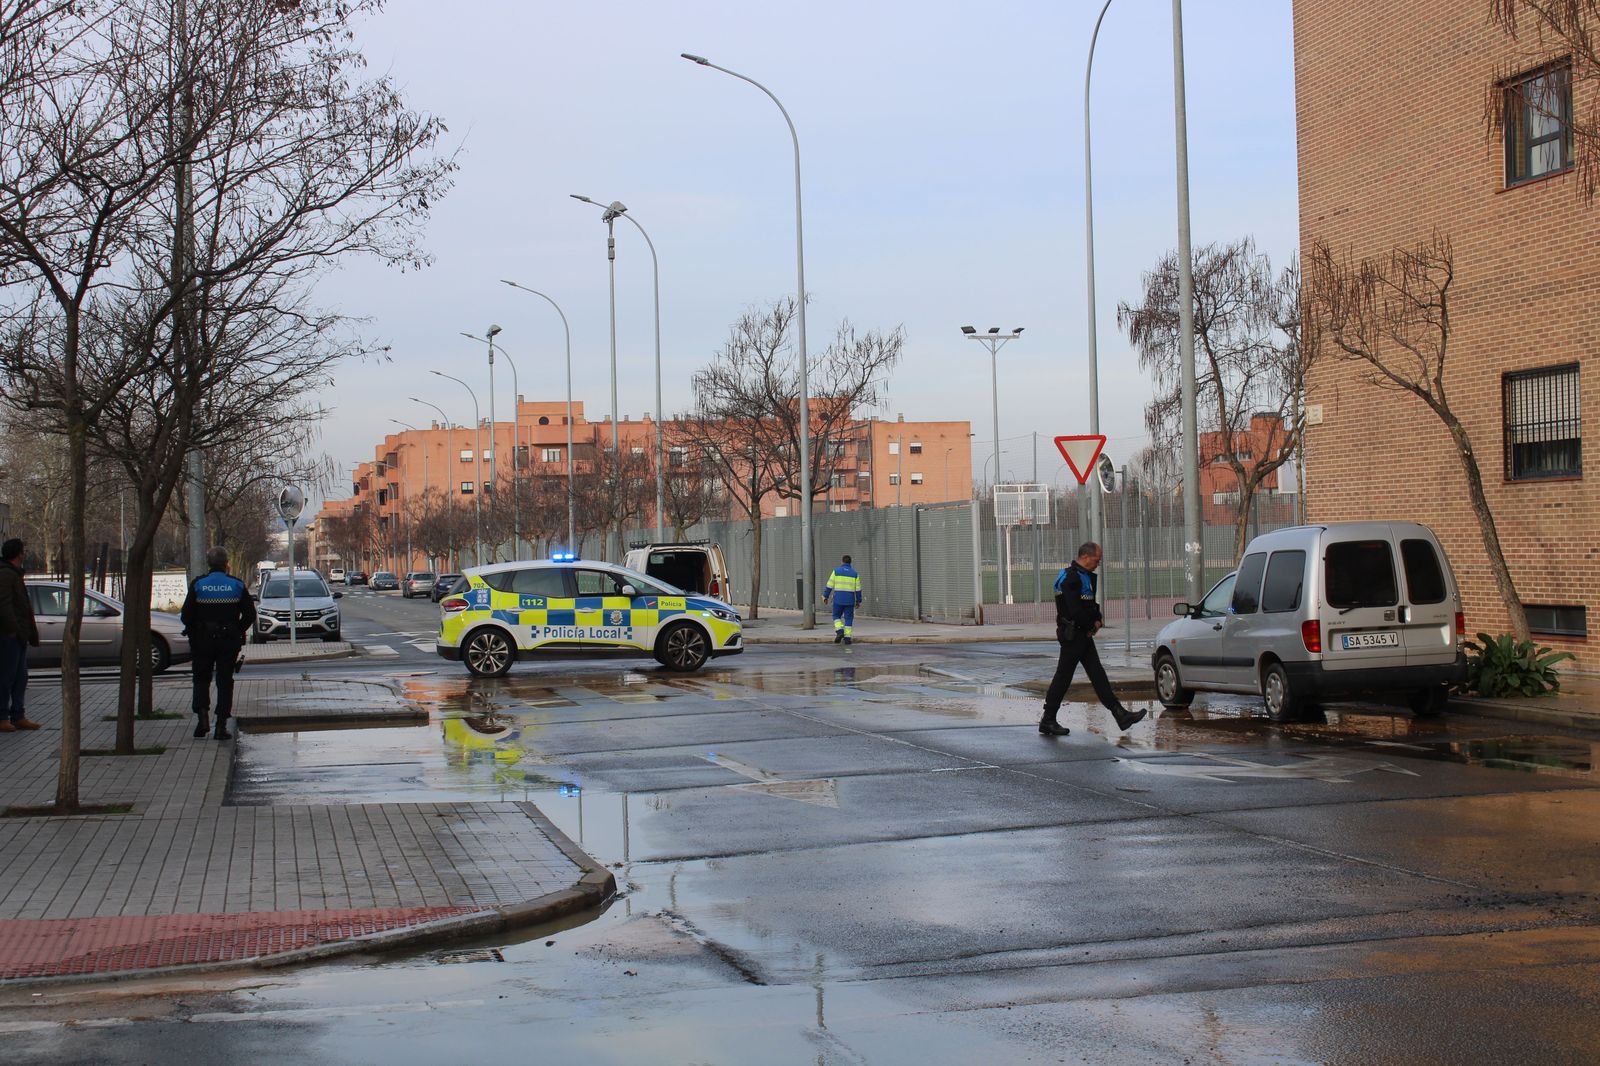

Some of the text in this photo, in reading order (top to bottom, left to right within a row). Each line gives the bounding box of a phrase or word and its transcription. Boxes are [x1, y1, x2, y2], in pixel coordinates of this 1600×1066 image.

[202, 584, 233, 592] POLICÍA
[525, 598, 544, 606] 112
[543, 626, 621, 639] Policía Local
[1349, 634, 1396, 647] SA 5345 V
